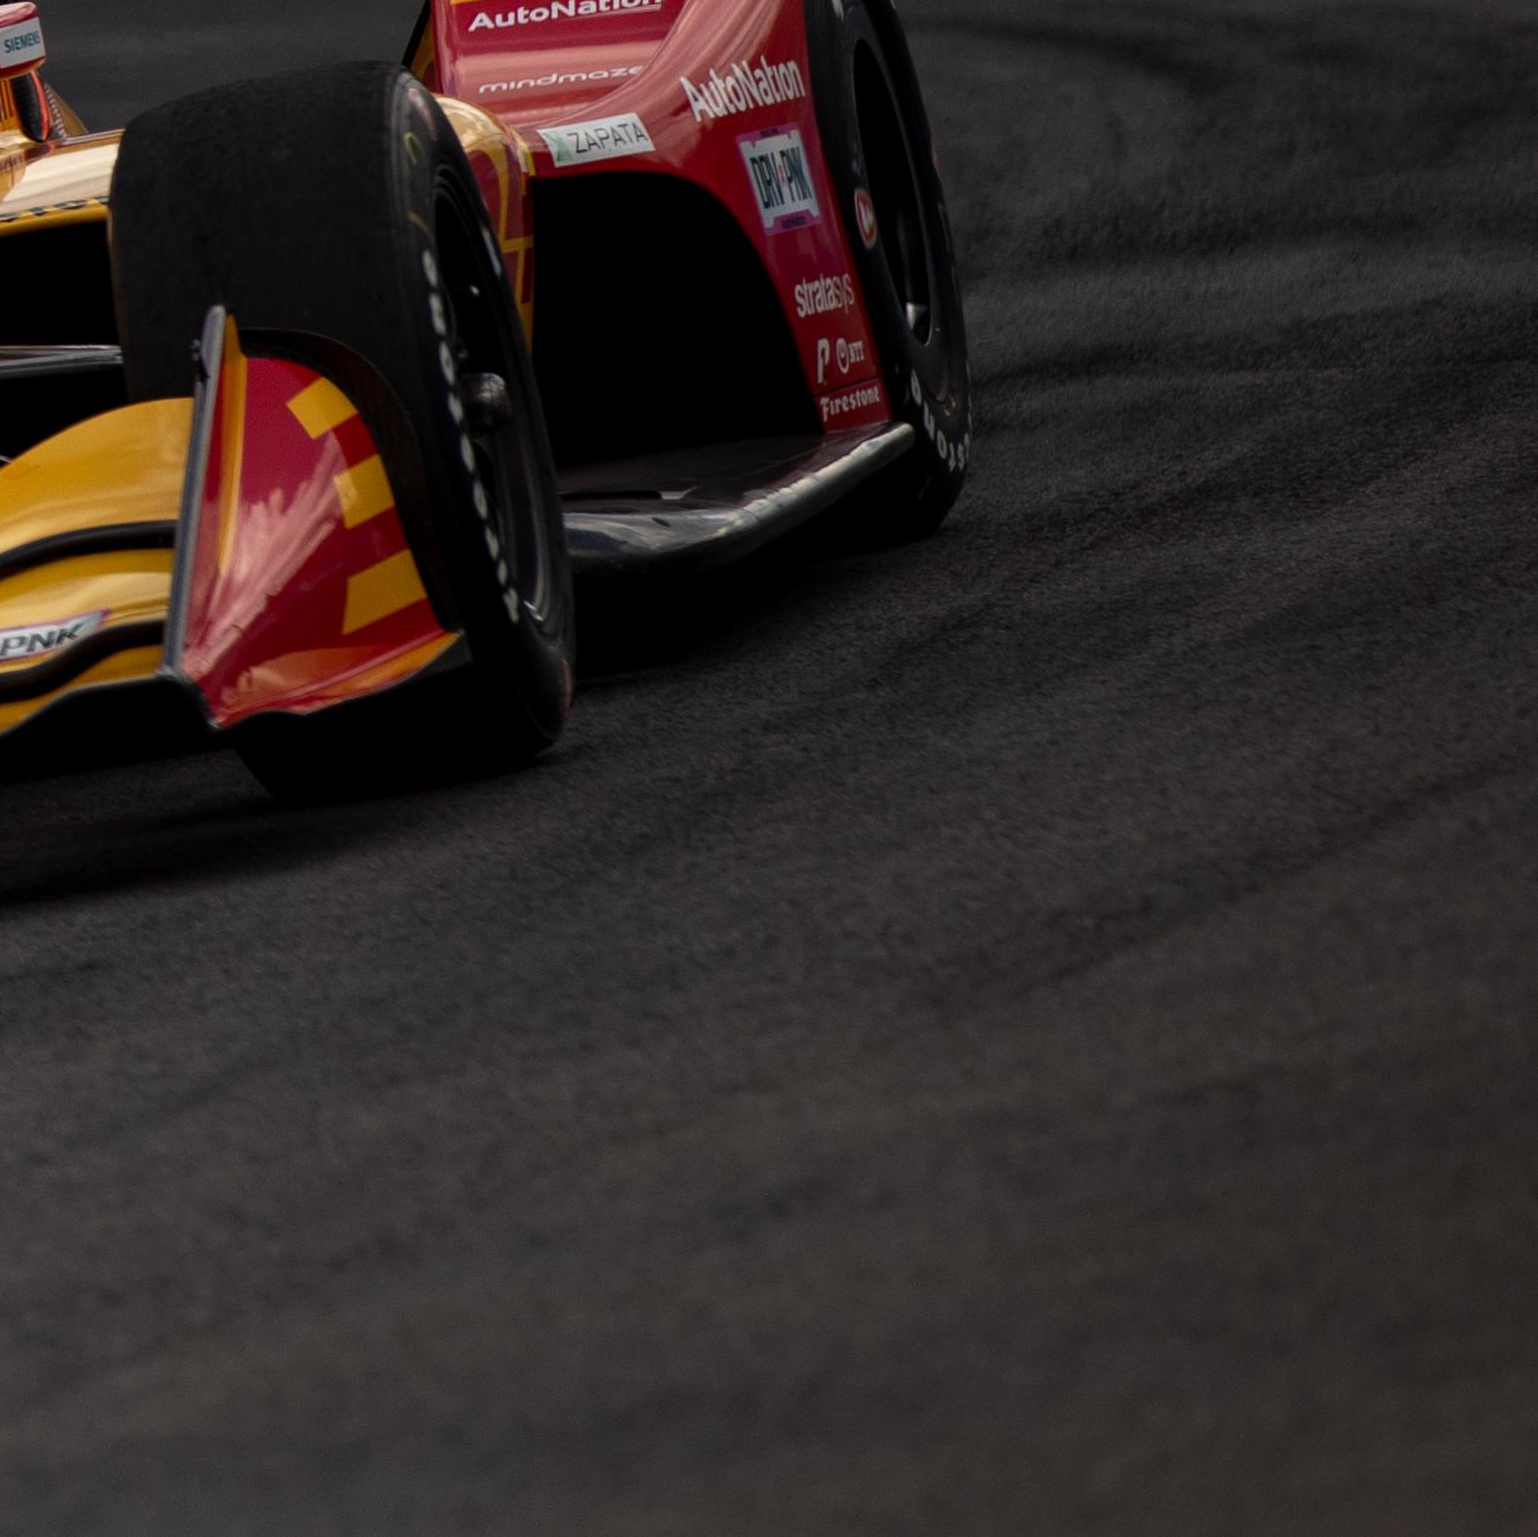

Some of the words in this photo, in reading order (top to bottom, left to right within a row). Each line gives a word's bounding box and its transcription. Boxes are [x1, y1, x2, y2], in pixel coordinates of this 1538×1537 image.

[3, 30, 42, 54] SIEMENS
[478, 65, 646, 94] mindmaze
[680, 54, 806, 123] AutoNation
[567, 122, 649, 154] ZAPATA
[749, 151, 785, 209] DRV
[793, 273, 856, 318] stratasys
[819, 385, 881, 423] Firestone
